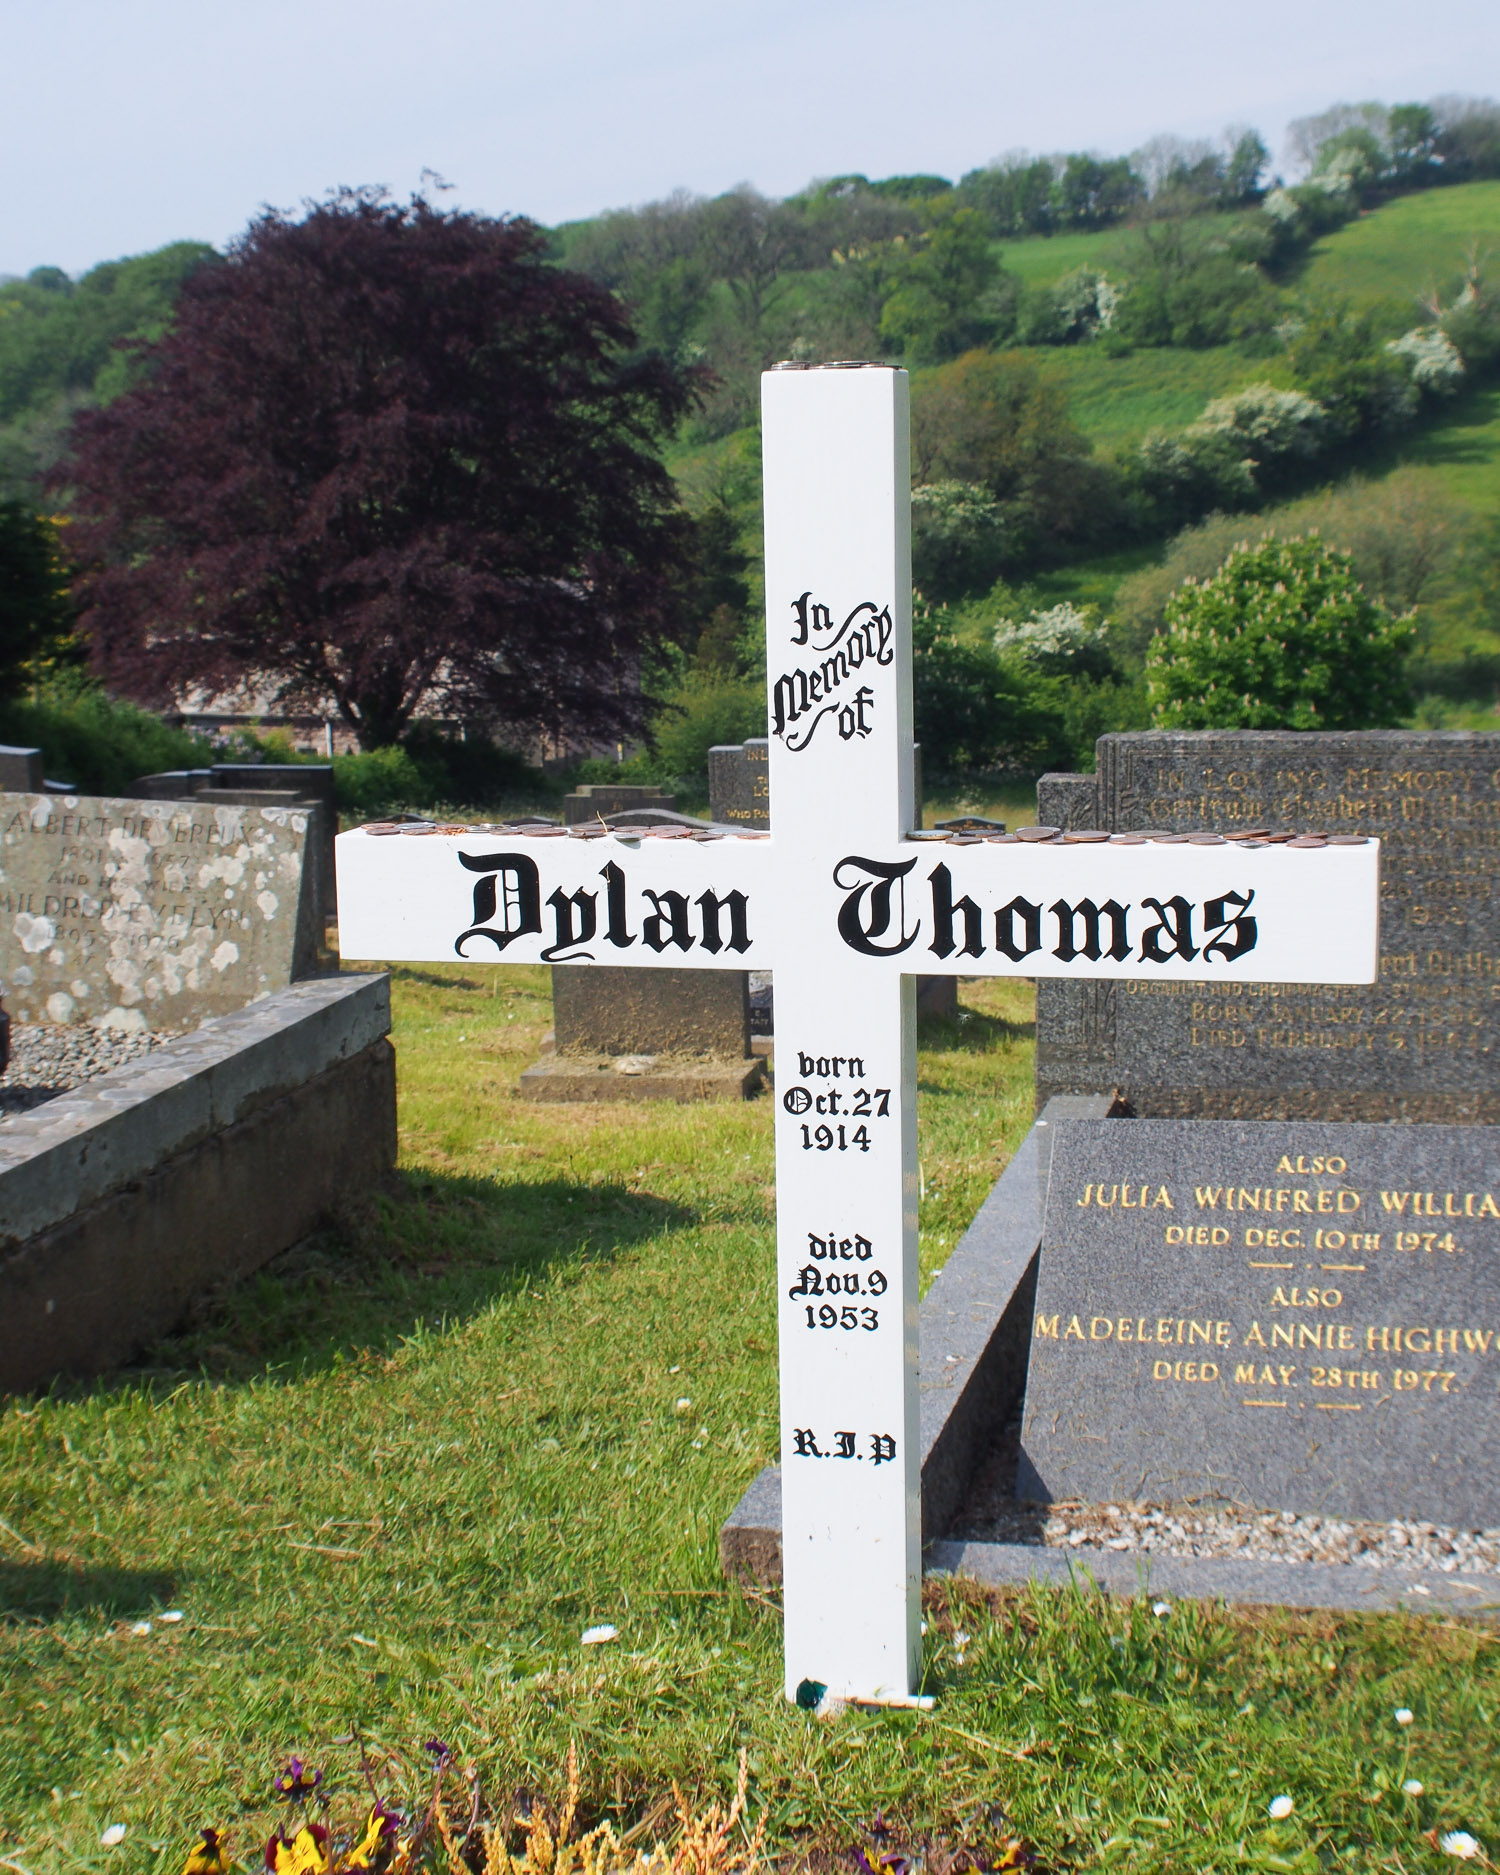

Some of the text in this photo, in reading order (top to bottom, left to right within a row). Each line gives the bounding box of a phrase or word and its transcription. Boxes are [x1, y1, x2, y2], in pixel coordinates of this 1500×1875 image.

[790, 591, 834, 646] In
[771, 603, 894, 736] Memory
[838, 685, 874, 741] of
[1157, 768, 1185, 792] IN
[1346, 768, 1476, 792] MEMORY
[727, 808, 752, 819] WHO
[455, 850, 1258, 964] Dylan Thomas
[1191, 1002, 1254, 1023] BORN
[1266, 1003, 1365, 1025] JANUARY
[1191, 1027, 1247, 1048] DIED
[797, 1051, 866, 1078] born
[783, 1086, 891, 1117] Oct.27
[800, 1124, 871, 1152] 1914
[1276, 1155, 1348, 1175] ALSO
[1077, 1183, 1175, 1209] JULIA
[1194, 1186, 1362, 1214] WINIFRED
[807, 1232, 873, 1262] died
[1165, 1226, 1231, 1246] DIED
[1245, 1228, 1306, 1248] DEC.
[1314, 1228, 1381, 1250] 10TH
[789, 1264, 888, 1302] Nov.9
[1270, 1286, 1343, 1308] ALSO
[805, 1304, 879, 1332] 1953
[1035, 1314, 1500, 1355] MADELEINE ANNIE HIGHW
[1153, 1361, 1220, 1383] DIED
[1311, 1366, 1380, 1389] 28TH
[793, 1428, 897, 1466] R.I.P
